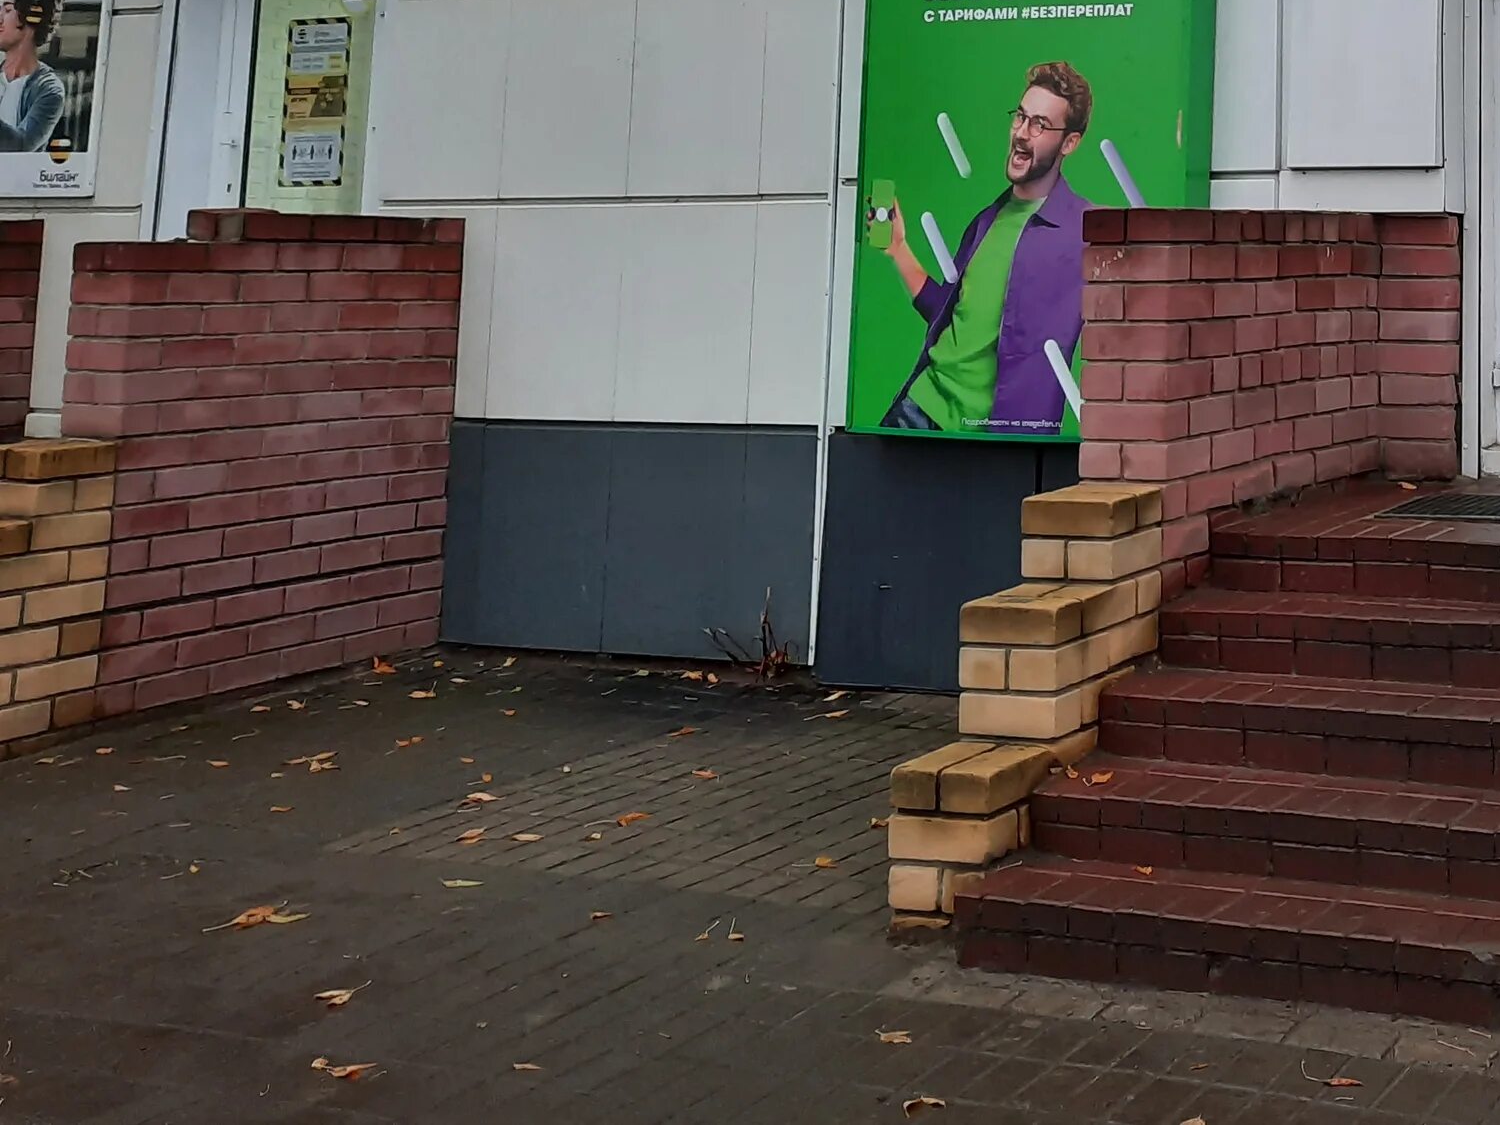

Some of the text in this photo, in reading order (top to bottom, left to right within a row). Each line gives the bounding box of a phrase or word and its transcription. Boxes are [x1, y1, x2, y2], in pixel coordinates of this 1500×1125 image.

[924, 4, 1134, 22] С ТАРИФАМИ #БЕЗПЕРЕПЛАТ
